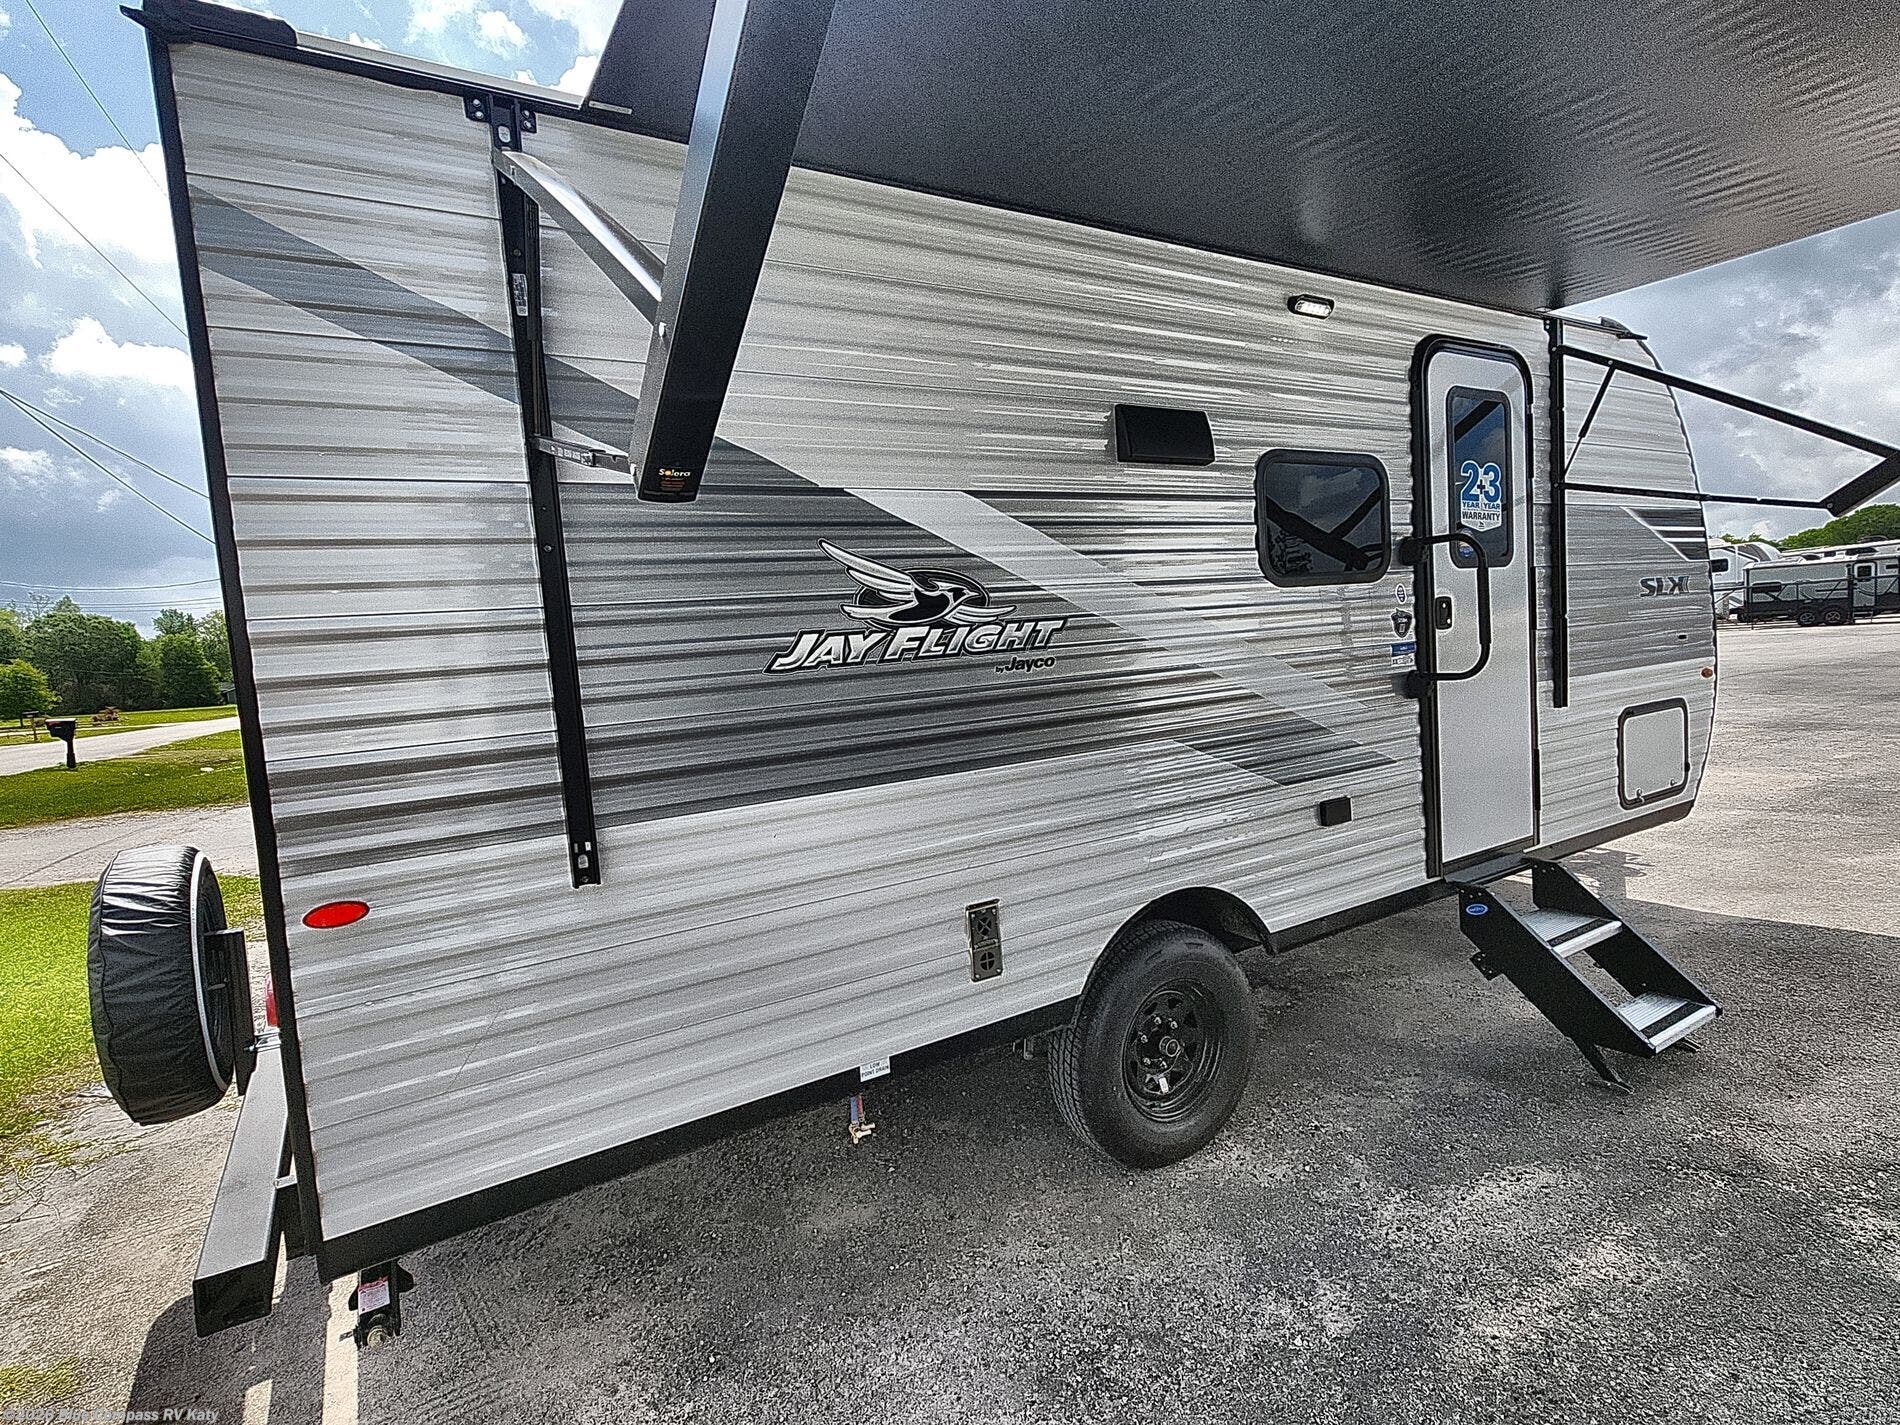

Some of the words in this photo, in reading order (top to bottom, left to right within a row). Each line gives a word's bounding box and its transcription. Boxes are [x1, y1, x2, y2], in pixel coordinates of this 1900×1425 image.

[658, 468, 691, 477] Solera
[1462, 501, 1480, 509] YEAR
[1482, 502, 1500, 510] YEAR
[1461, 510, 1500, 521] WARRANTY
[1640, 576, 1690, 597] SLX
[767, 629, 888, 673] JAY
[879, 619, 1068, 662] FLIGHT
[995, 665, 1005, 674] by
[1004, 656, 1056, 673] Jayco
[861, 1068, 875, 1078] POINT
[876, 1065, 889, 1073] DRAIN
